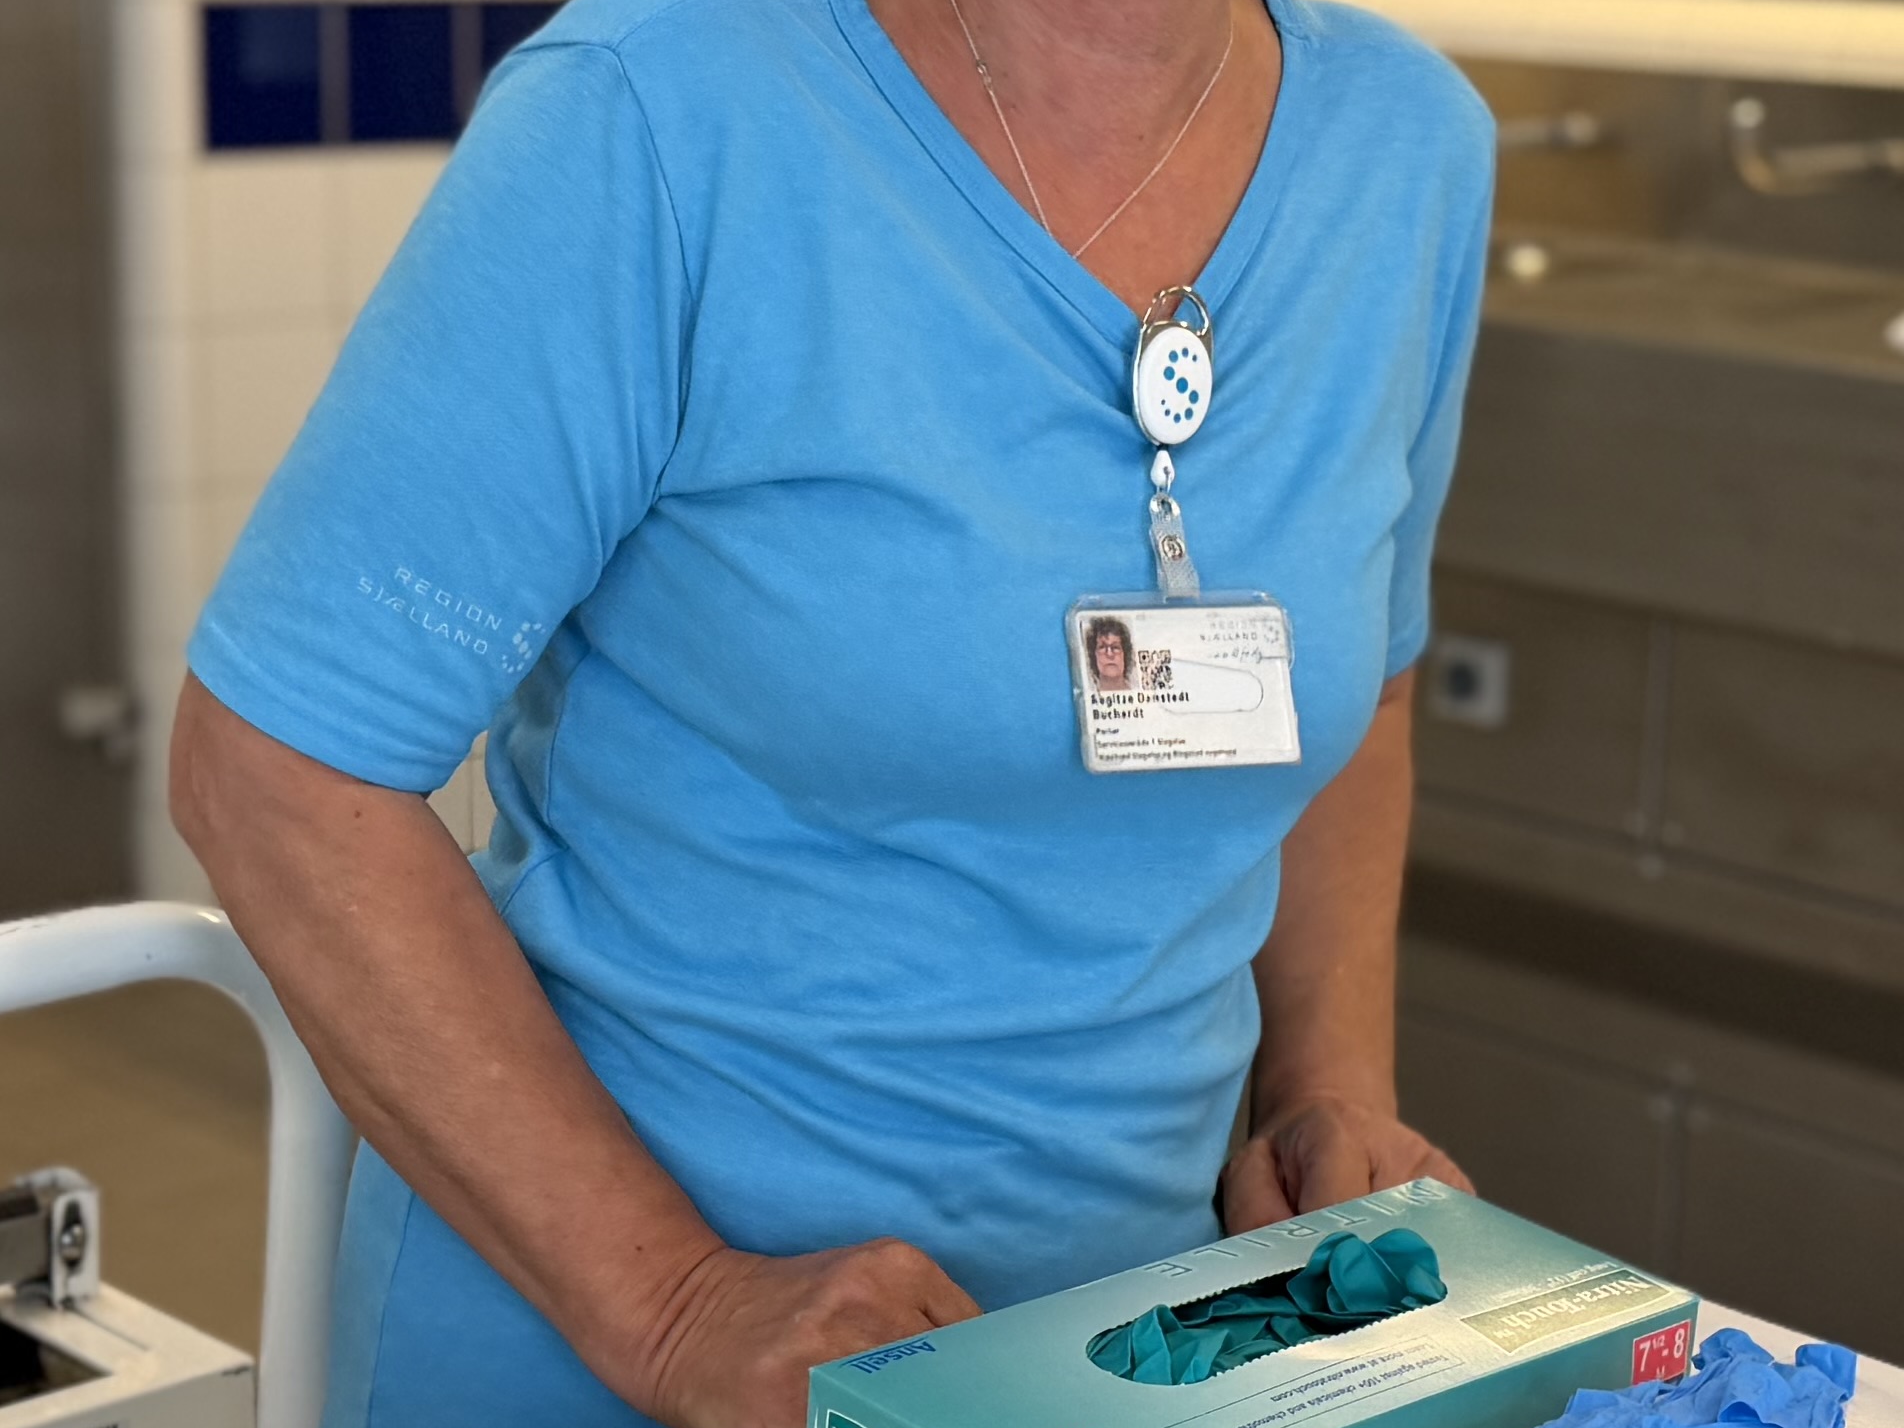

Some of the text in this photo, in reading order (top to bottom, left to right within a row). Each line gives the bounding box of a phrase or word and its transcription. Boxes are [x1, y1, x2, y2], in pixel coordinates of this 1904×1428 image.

[394, 566, 502, 631] REGION
[1144, 1181, 1447, 1278] NITRILE
[851, 1338, 937, 1373] Ansell
[1673, 1328, 1686, 1359] 8
